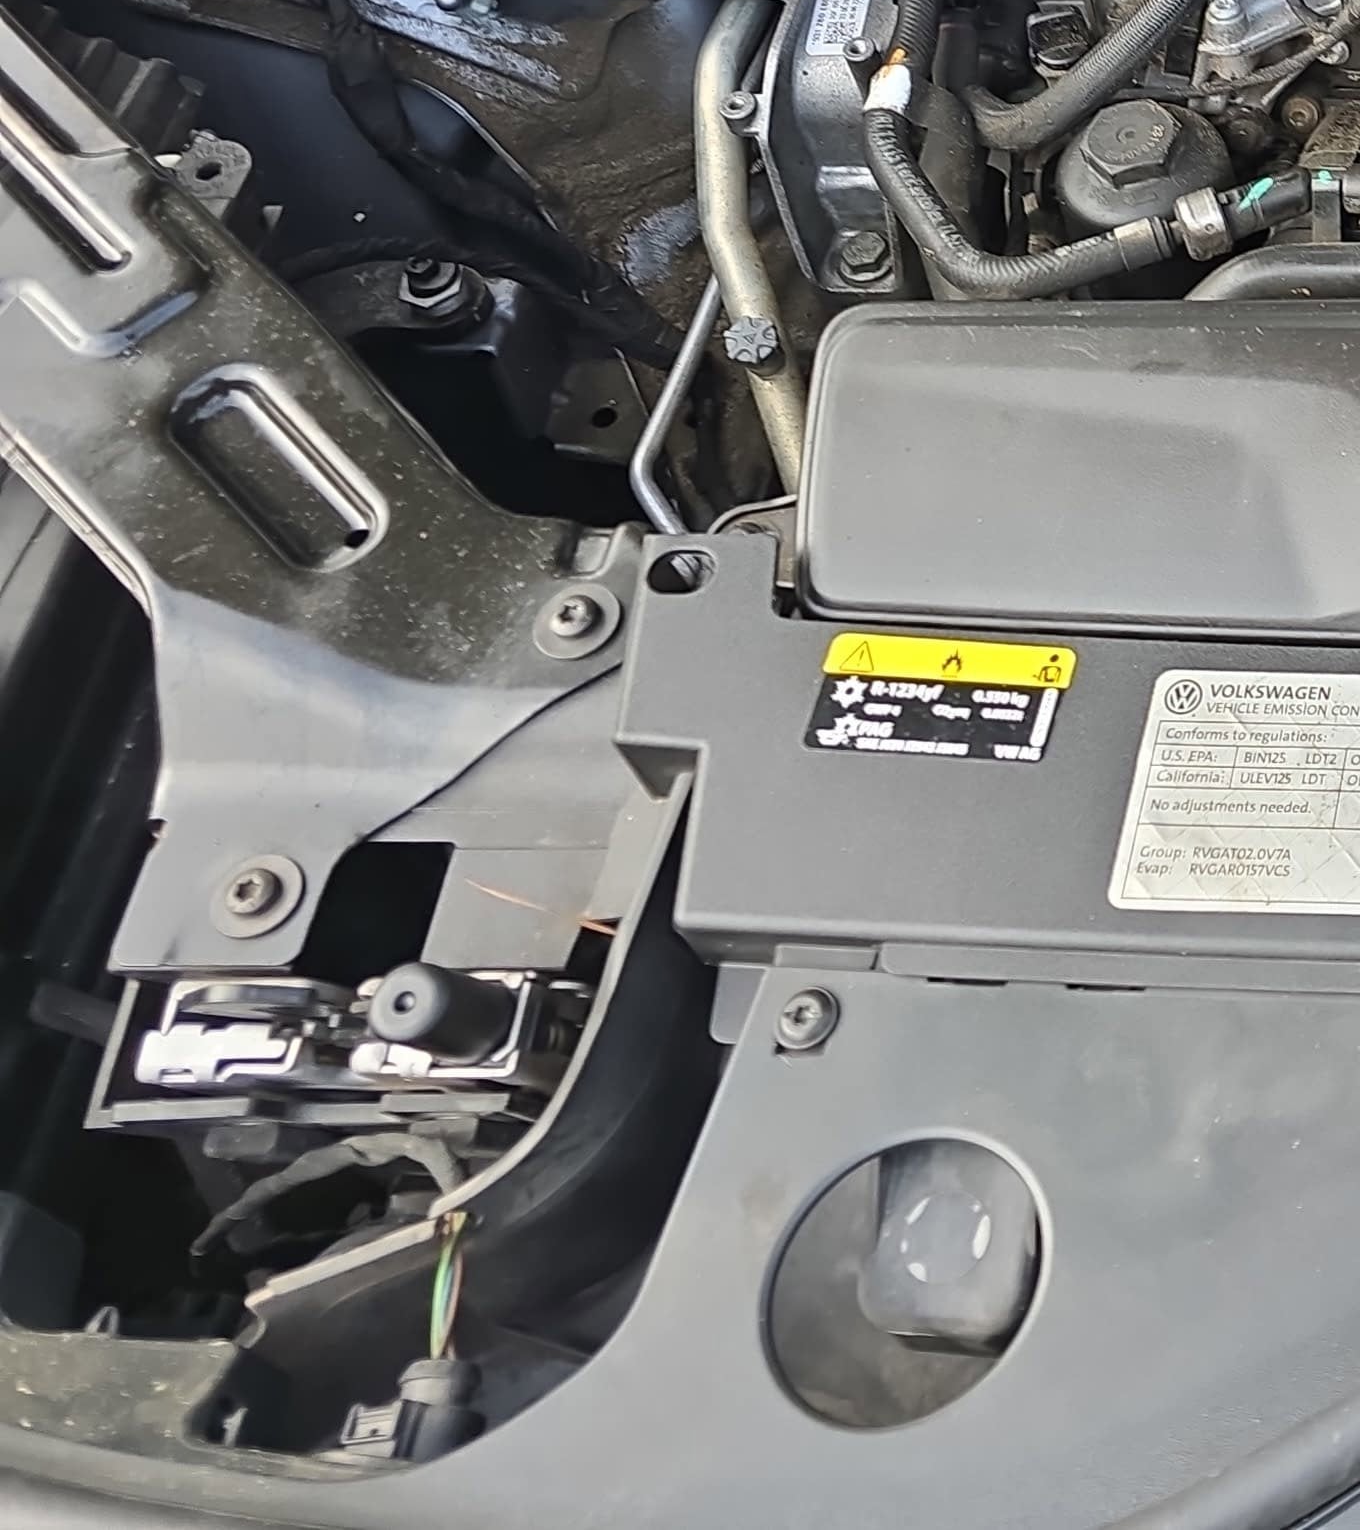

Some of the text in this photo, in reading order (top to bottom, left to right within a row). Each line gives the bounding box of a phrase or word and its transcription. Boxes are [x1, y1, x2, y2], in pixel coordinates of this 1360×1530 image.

[1010, 692, 1030, 708] kg
[1210, 685, 1331, 700] VOLKSWAGEN
[1207, 703, 1259, 714] VEHICLE
[1264, 704, 1327, 716] EMISSION
[858, 721, 895, 737] PAG
[1166, 728, 1327, 743] Conforms to regulations:
[993, 744, 1042, 761] VW AG
[1161, 751, 1217, 762] U.S. EPA:
[1244, 752, 1336, 764] BIN125 LDT2
[1157, 770, 1224, 783] California:
[1240, 773, 1326, 784] ULEV125 LDT
[1150, 799, 1311, 814] No adjustments needed.
[1140, 846, 1186, 862] Group:
[1137, 861, 1172, 875] Evap:
